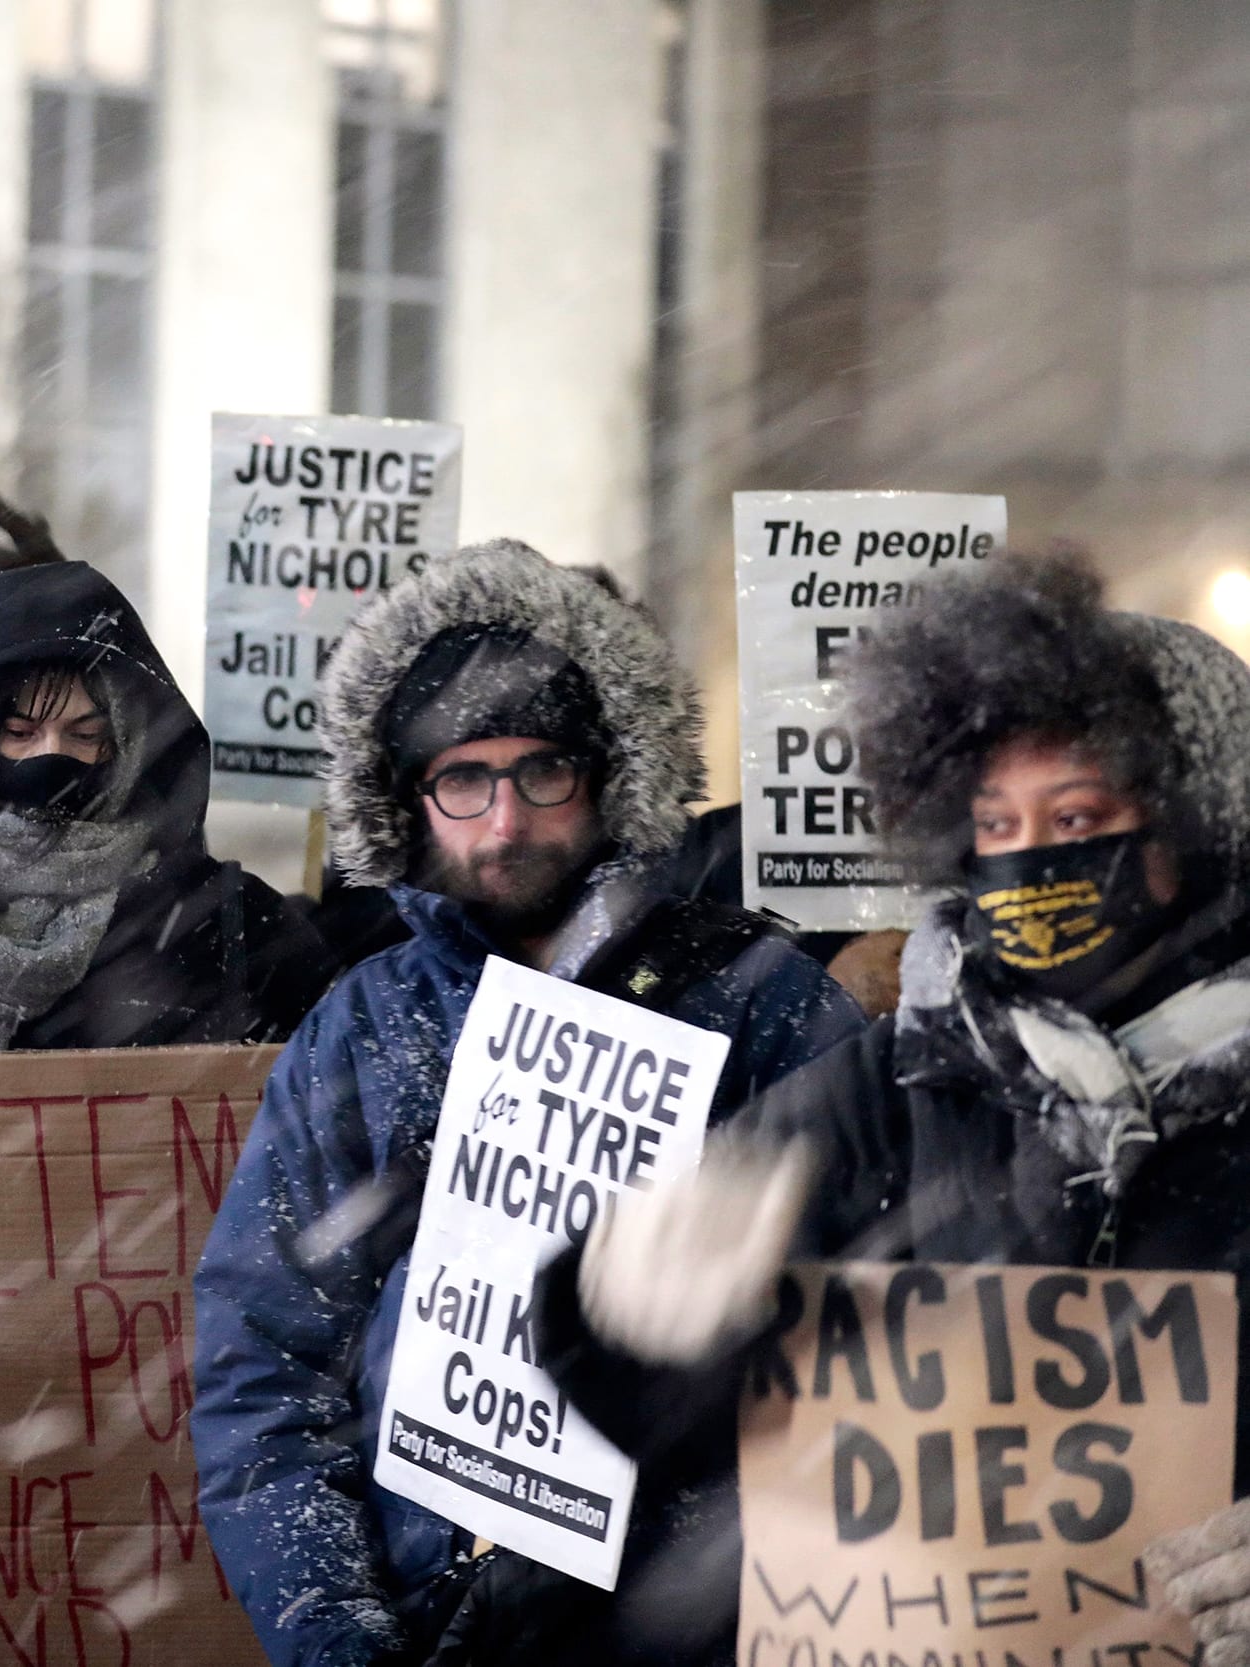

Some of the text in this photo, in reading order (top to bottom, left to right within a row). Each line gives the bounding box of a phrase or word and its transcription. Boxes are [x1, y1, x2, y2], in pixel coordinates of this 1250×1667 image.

[235, 443, 435, 496] JUSTICE
[238, 492, 422, 545] for TYRE
[764, 521, 994, 567] The people
[220, 631, 297, 678] Jail
[763, 786, 877, 835] TER
[762, 858, 803, 884] Party
[807, 858, 829, 879] for
[488, 1003, 692, 1127] JUSTICE
[474, 1070, 662, 1193] for TYRE
[448, 1135, 618, 1246] NICHO
[417, 1265, 495, 1348] Jail
[750, 1266, 1210, 1412] RACISM
[444, 1351, 570, 1456] Cops!
[393, 1420, 606, 1530] Party for Socialism & Liberation
[832, 1419, 1134, 1547] DIES
[752, 1558, 1148, 1630] WHEN
